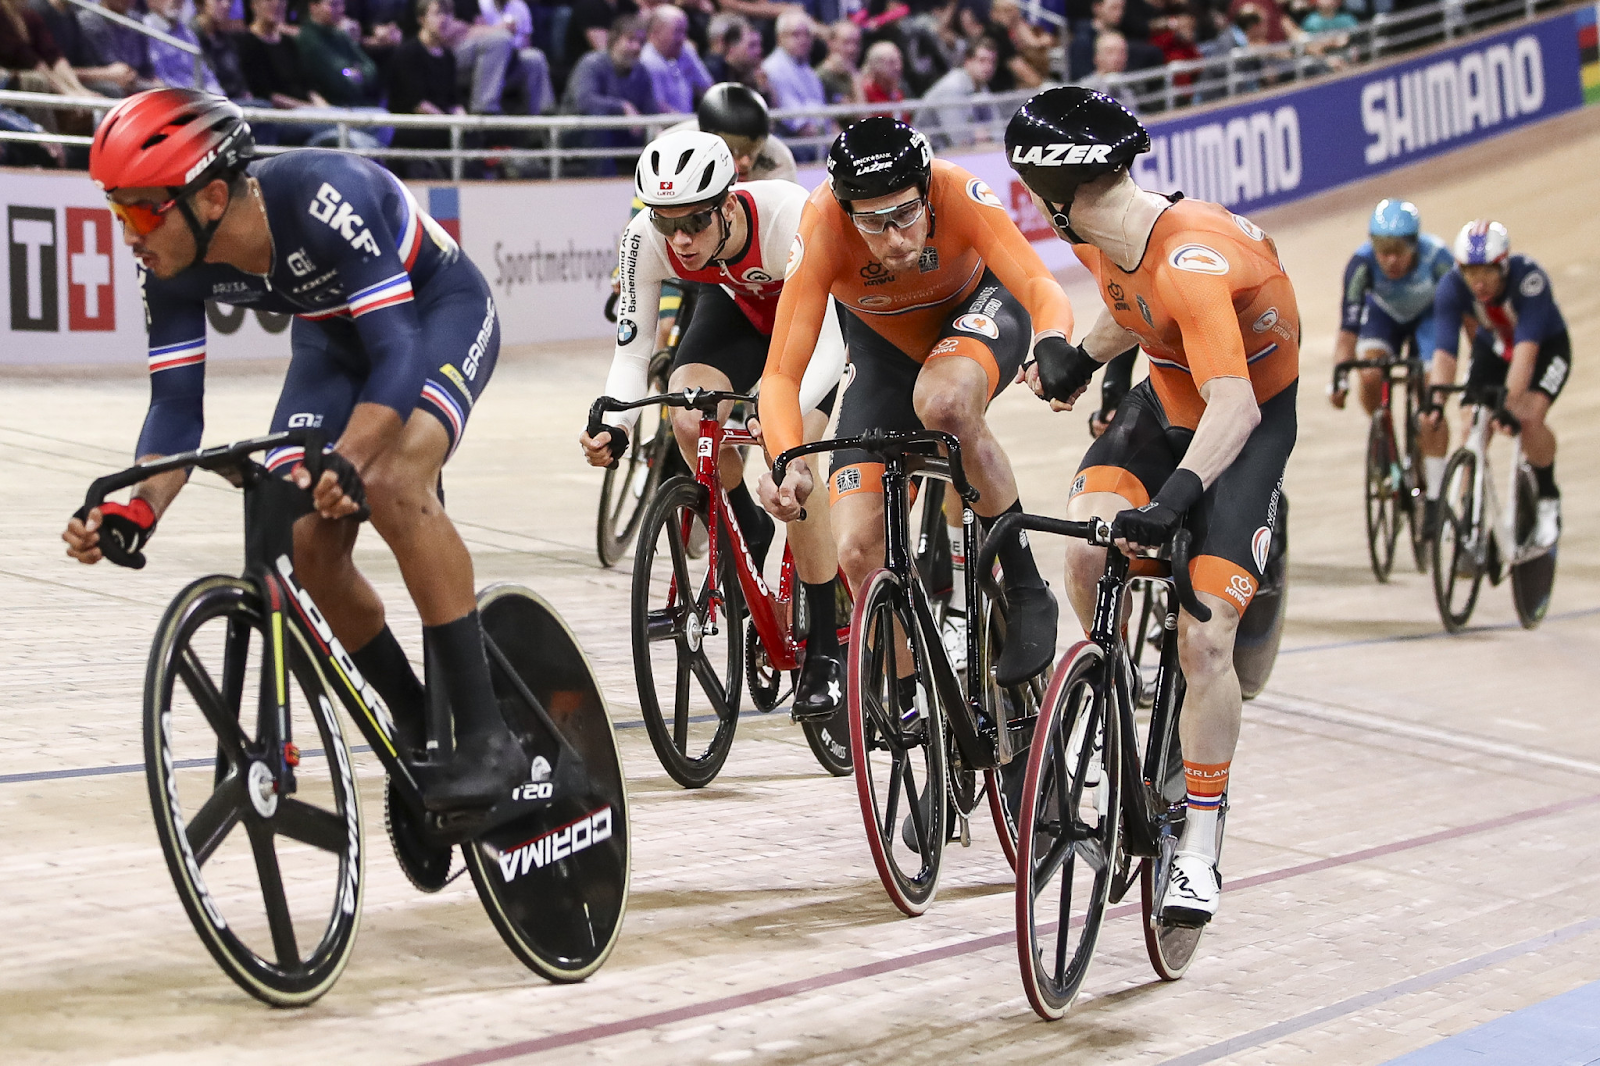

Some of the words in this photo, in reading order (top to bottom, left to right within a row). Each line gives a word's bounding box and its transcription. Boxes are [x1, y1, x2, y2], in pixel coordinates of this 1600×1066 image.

[1361, 35, 1547, 165] SHIMANO
[185, 150, 217, 184] BELL
[855, 161, 893, 176] LAZER
[1012, 142, 1113, 167] LAZER
[308, 182, 381, 257] SKF
[627, 233, 642, 314] Bachenbülach
[275, 553, 398, 742] LOOK
[1106, 585, 1119, 635] KOGA
[820, 727, 831, 746] DT
[830, 739, 847, 760] SWISS
[319, 692, 359, 914] CORIMA
[498, 805, 613, 883] CORIMA
